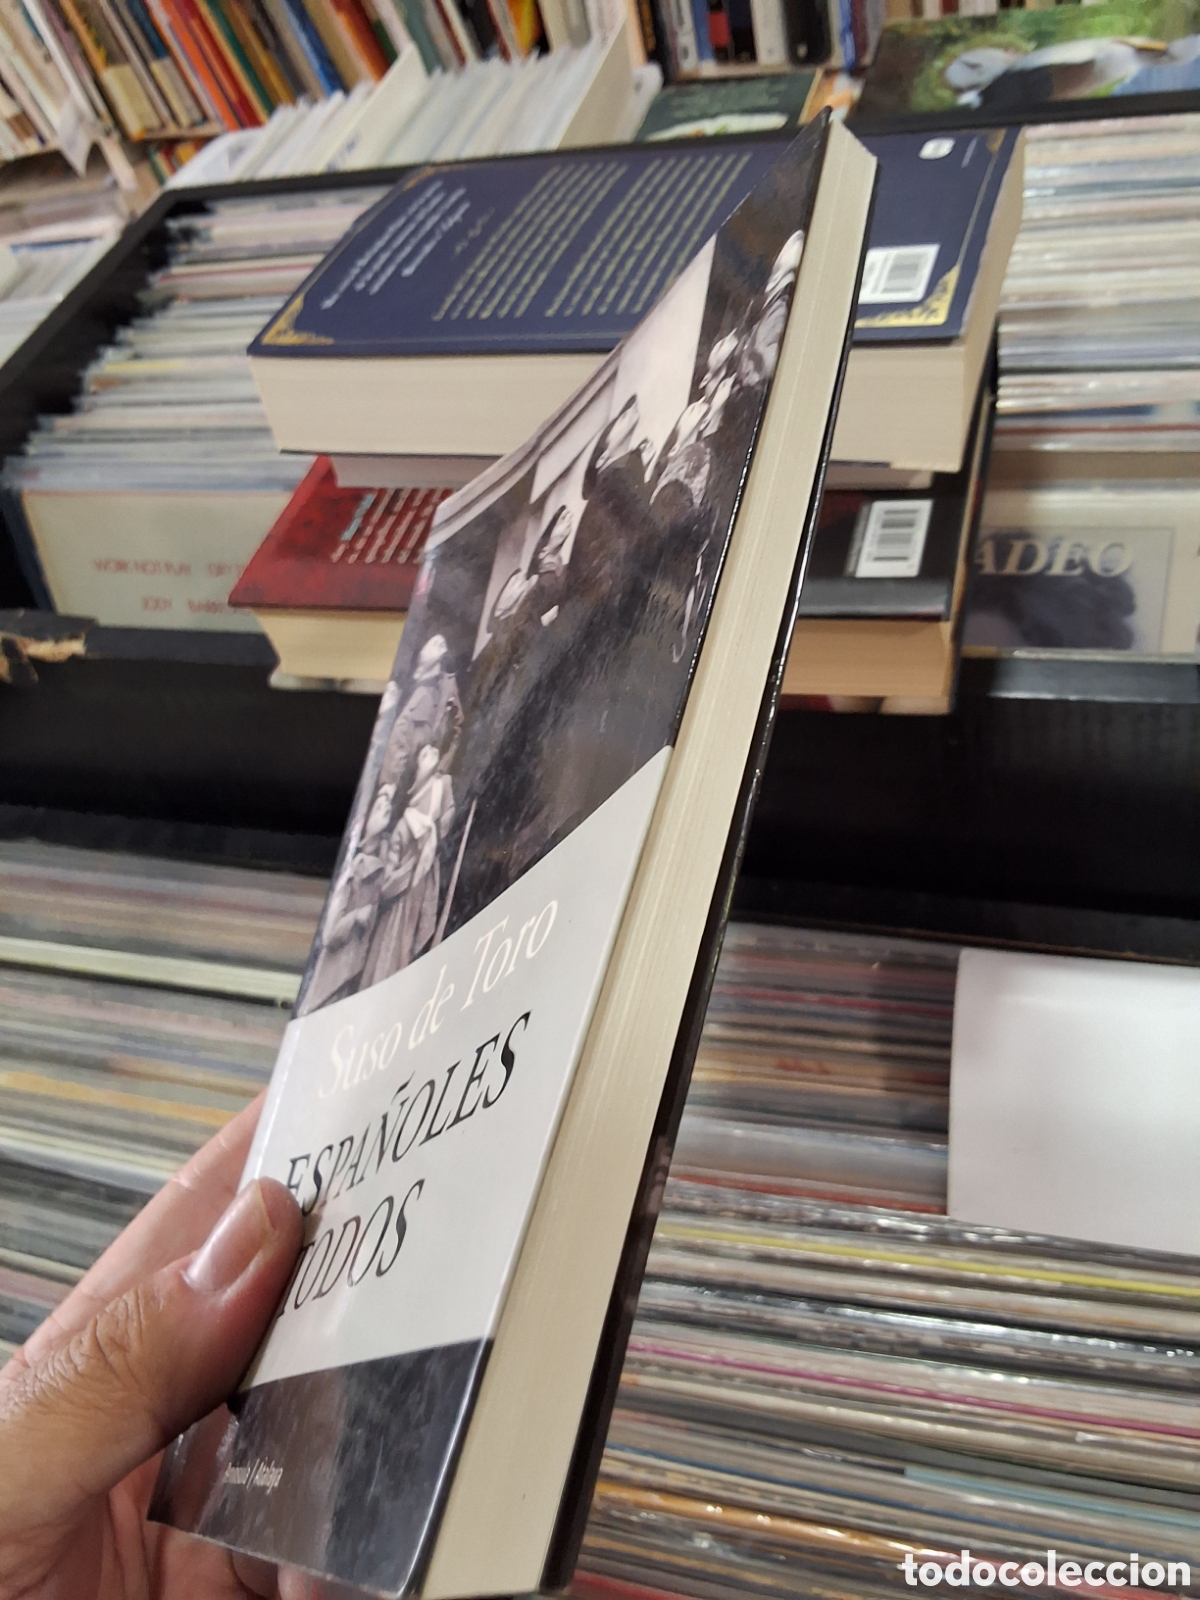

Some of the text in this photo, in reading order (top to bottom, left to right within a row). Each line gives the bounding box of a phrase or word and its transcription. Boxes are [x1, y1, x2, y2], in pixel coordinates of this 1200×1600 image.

[318, 899, 559, 1100] Suso de Toro
[286, 1010, 532, 1217] ESPAÑOLES
